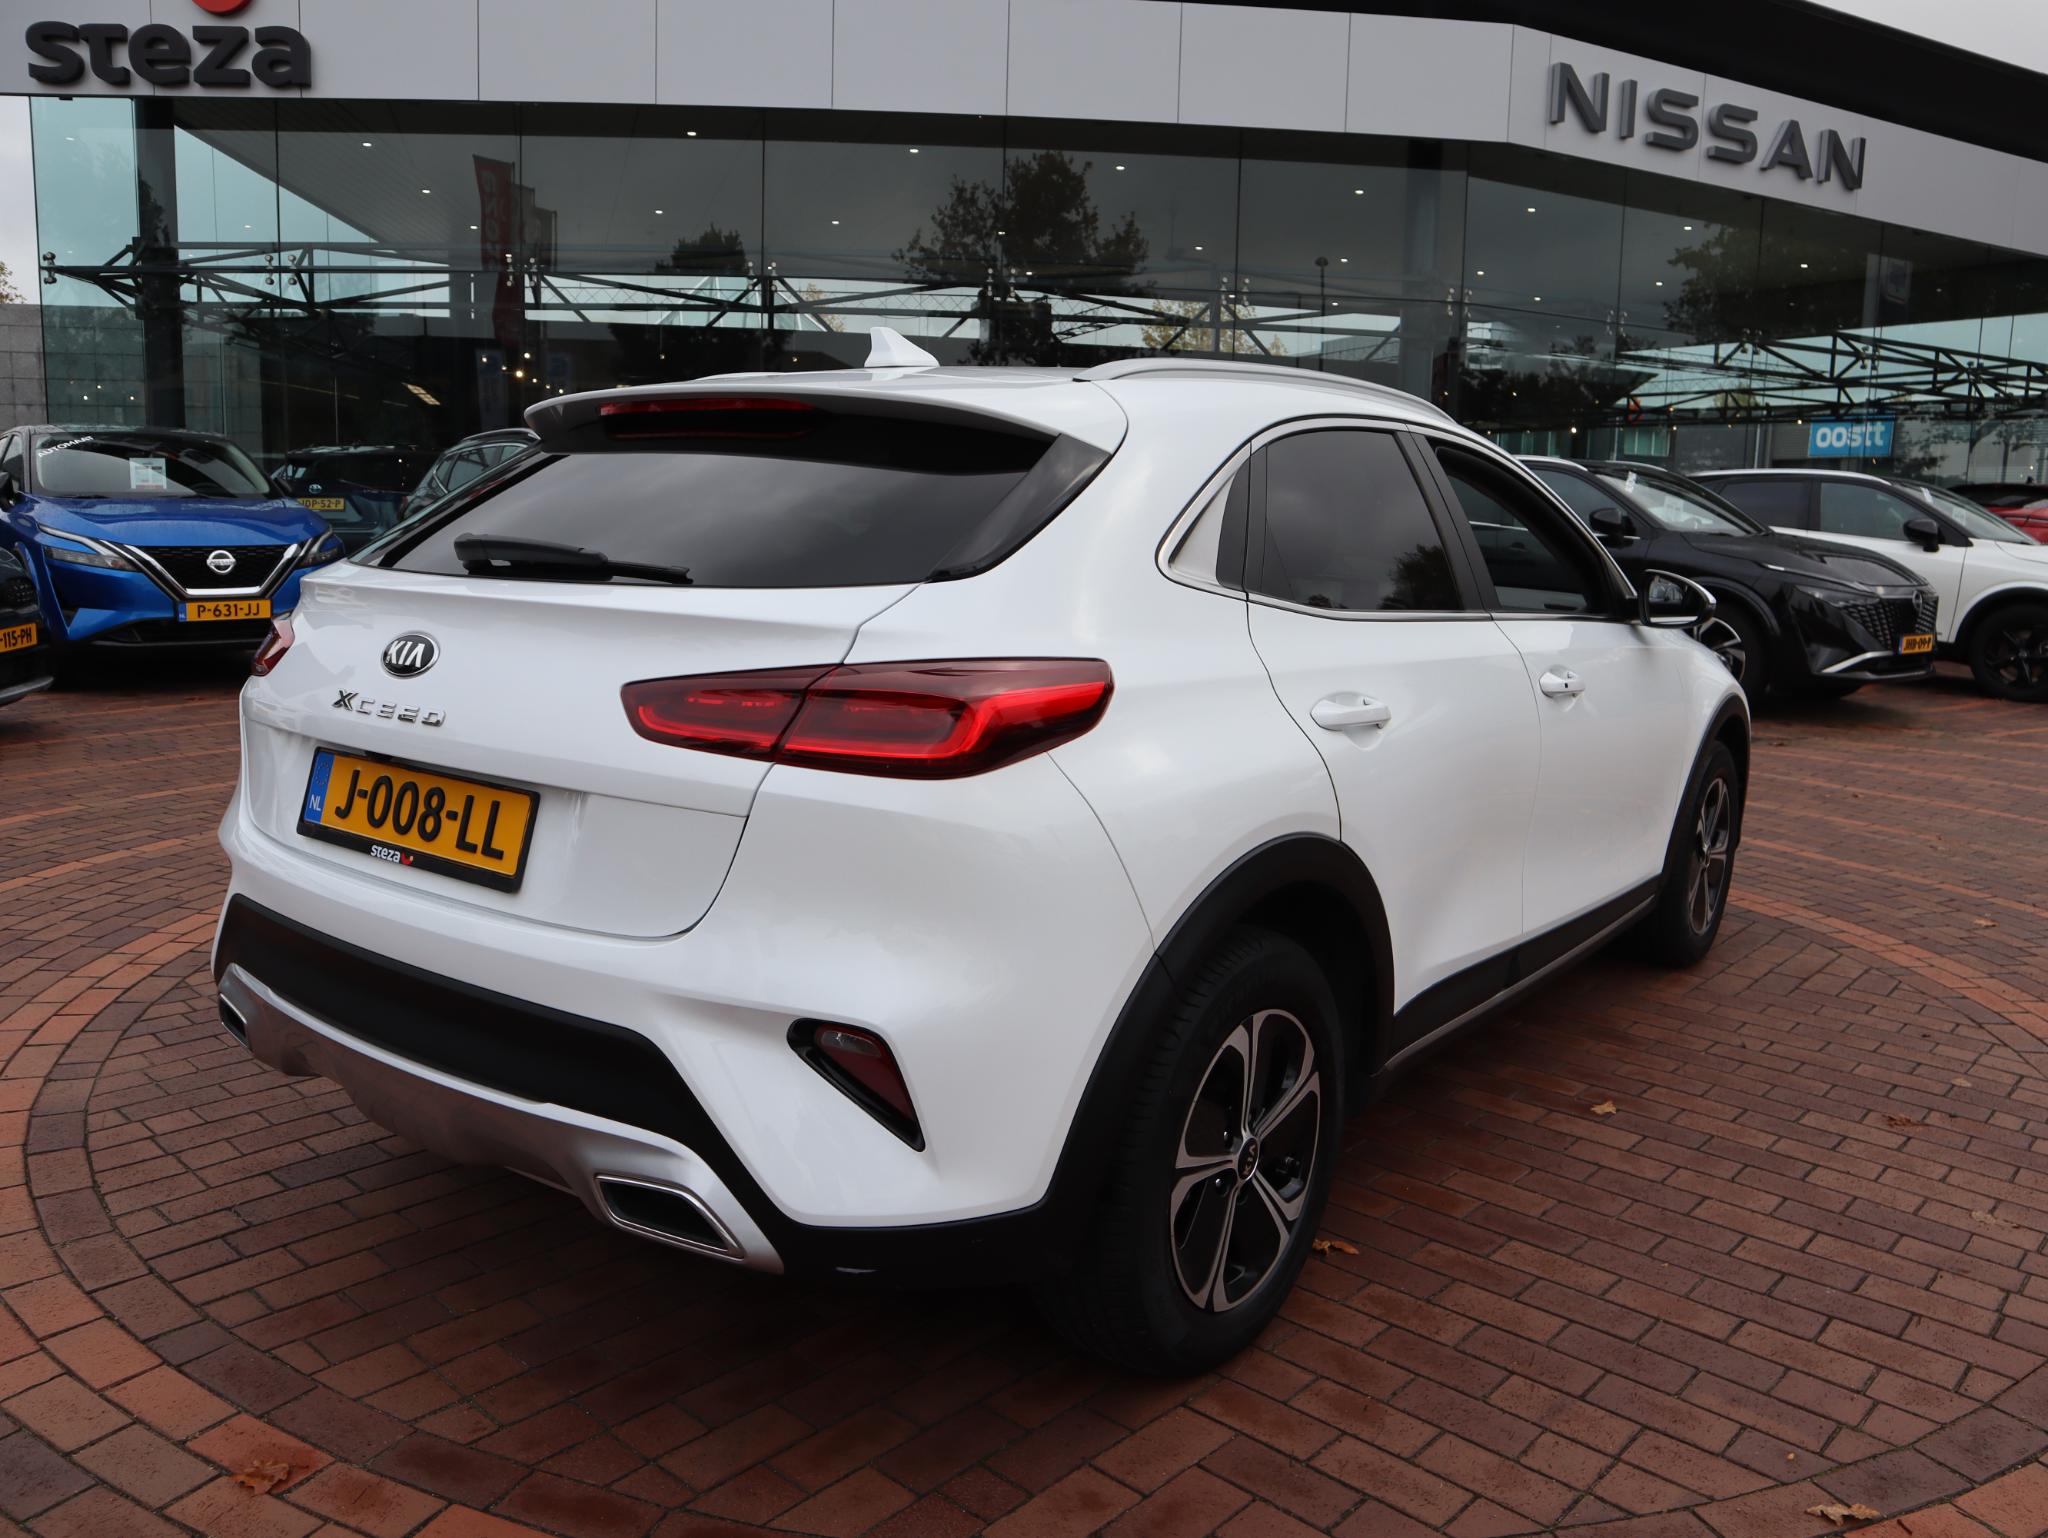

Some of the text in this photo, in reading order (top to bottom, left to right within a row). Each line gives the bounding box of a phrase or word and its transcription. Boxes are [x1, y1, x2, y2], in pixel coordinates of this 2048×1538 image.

[25, 21, 312, 89] steza
[1550, 62, 1867, 191] NISSAN
[38, 435, 94, 458] AUTOMAAT
[197, 602, 260, 618] P-631-JJ
[386, 641, 425, 668] KIA
[309, 770, 504, 859] NL J-008-LL
[371, 844, 401, 863] steza
